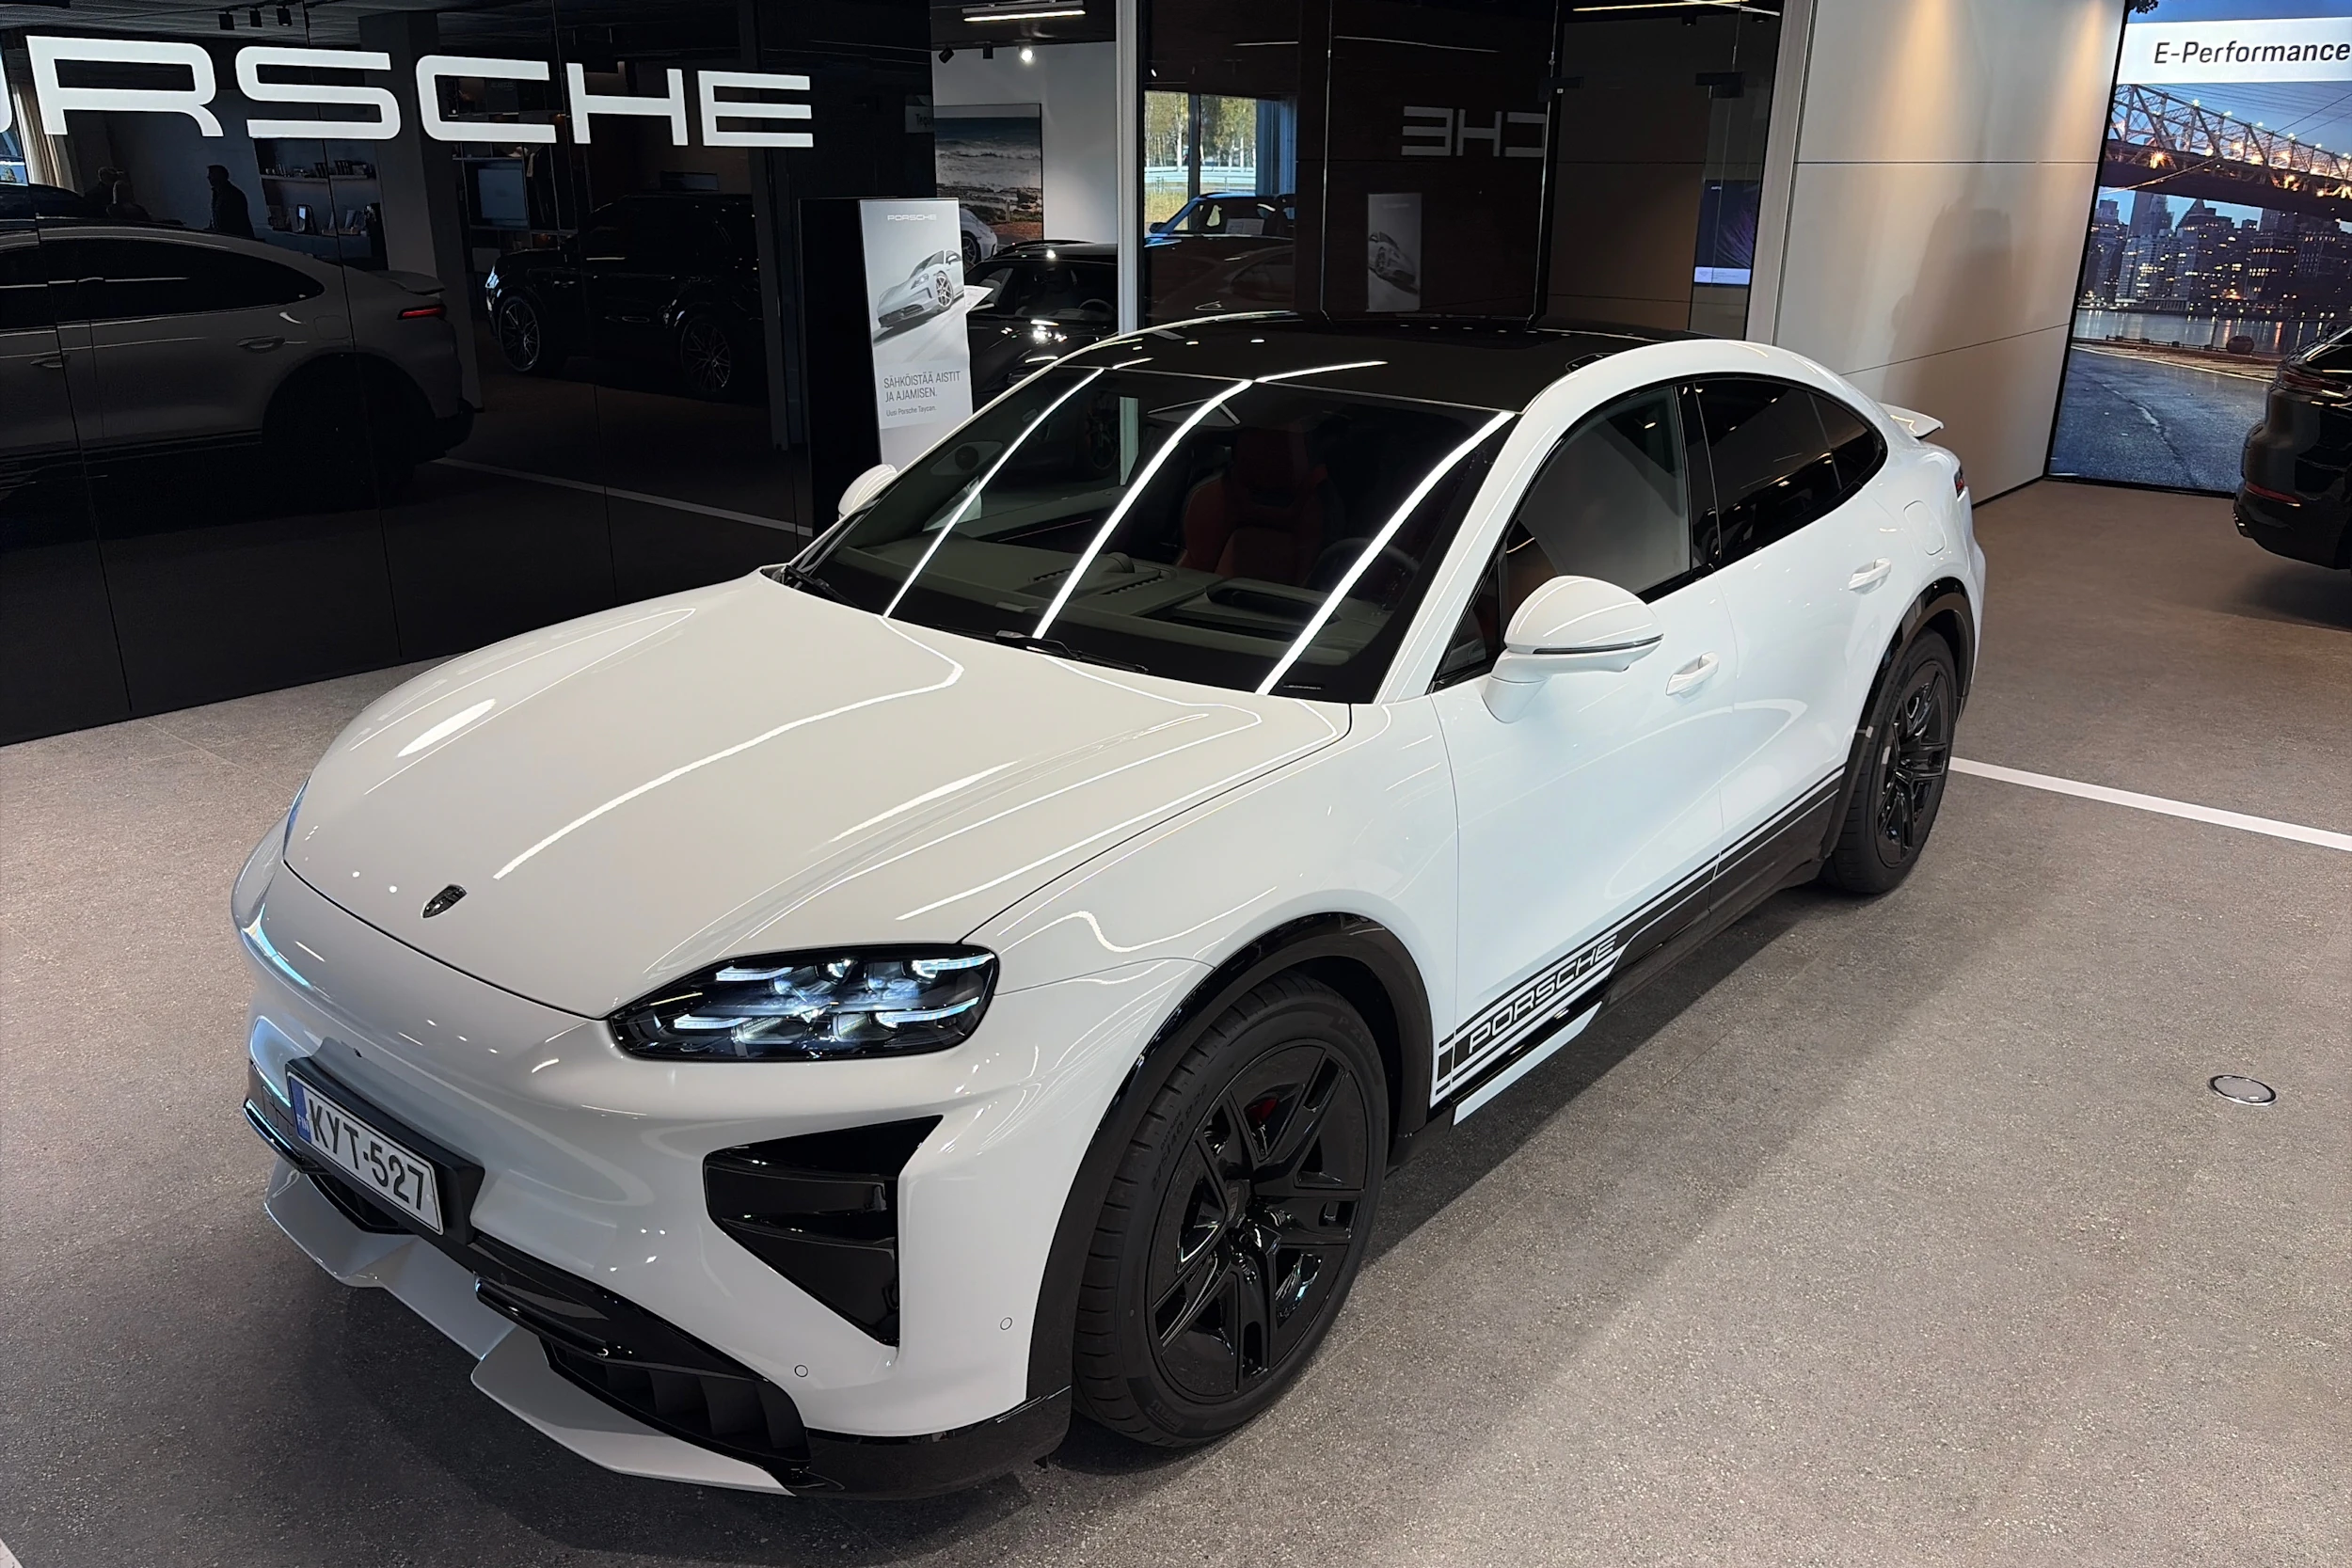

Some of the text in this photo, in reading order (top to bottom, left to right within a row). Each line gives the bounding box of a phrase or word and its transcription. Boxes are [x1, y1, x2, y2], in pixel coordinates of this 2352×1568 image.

[2154, 40, 2350, 64] E-Performance
[0, 35, 814, 148] RSCHE
[884, 371, 961, 388] SÄHKÖISTÄÄ AISTIT
[885, 387, 937, 403] JA AJAMISEN.
[886, 408, 898, 417] Uusi
[898, 406, 917, 416] Porsche
[1469, 934, 1617, 1054] PORSCHE
[296, 1114, 310, 1132] FIN
[309, 1099, 425, 1211] KYT-527
